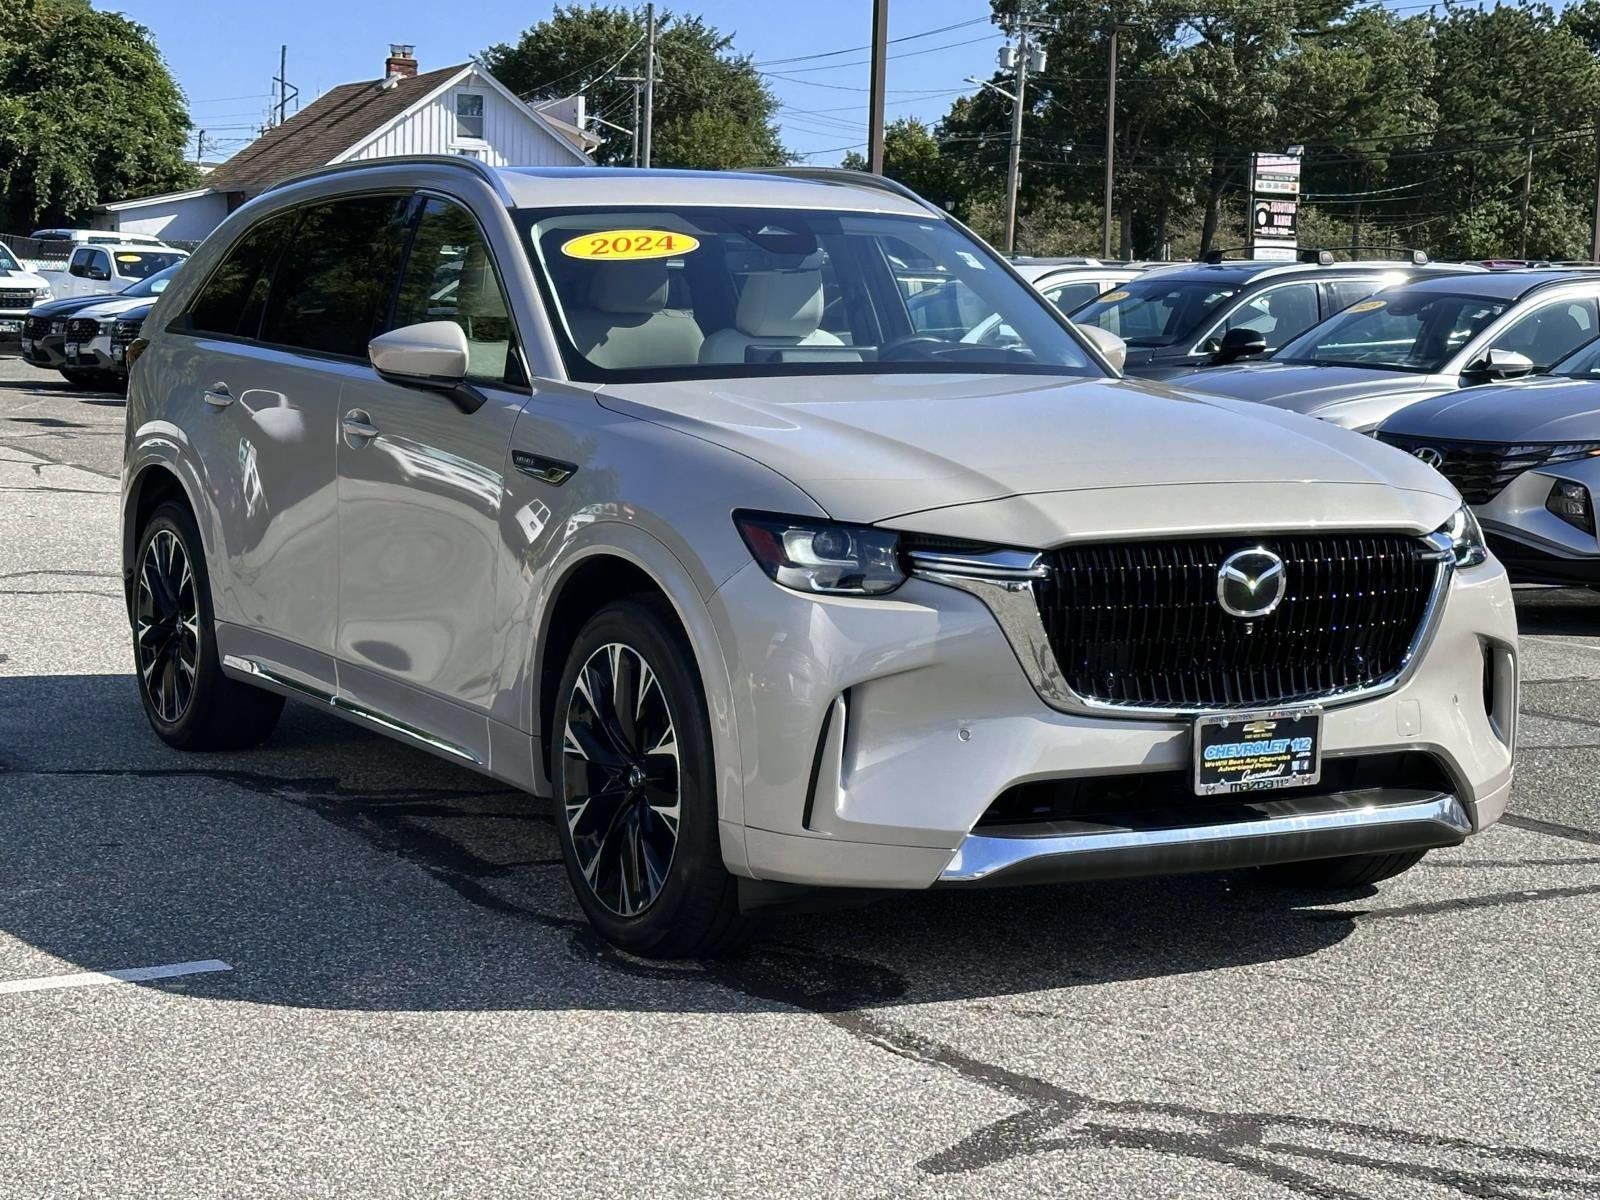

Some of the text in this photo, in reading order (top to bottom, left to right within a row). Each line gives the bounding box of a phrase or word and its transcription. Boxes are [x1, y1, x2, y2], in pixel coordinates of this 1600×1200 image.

[590, 235, 677, 256] 2024
[1204, 739, 1290, 759] CHEVROLET
[1259, 754, 1291, 762] Chevrolet
